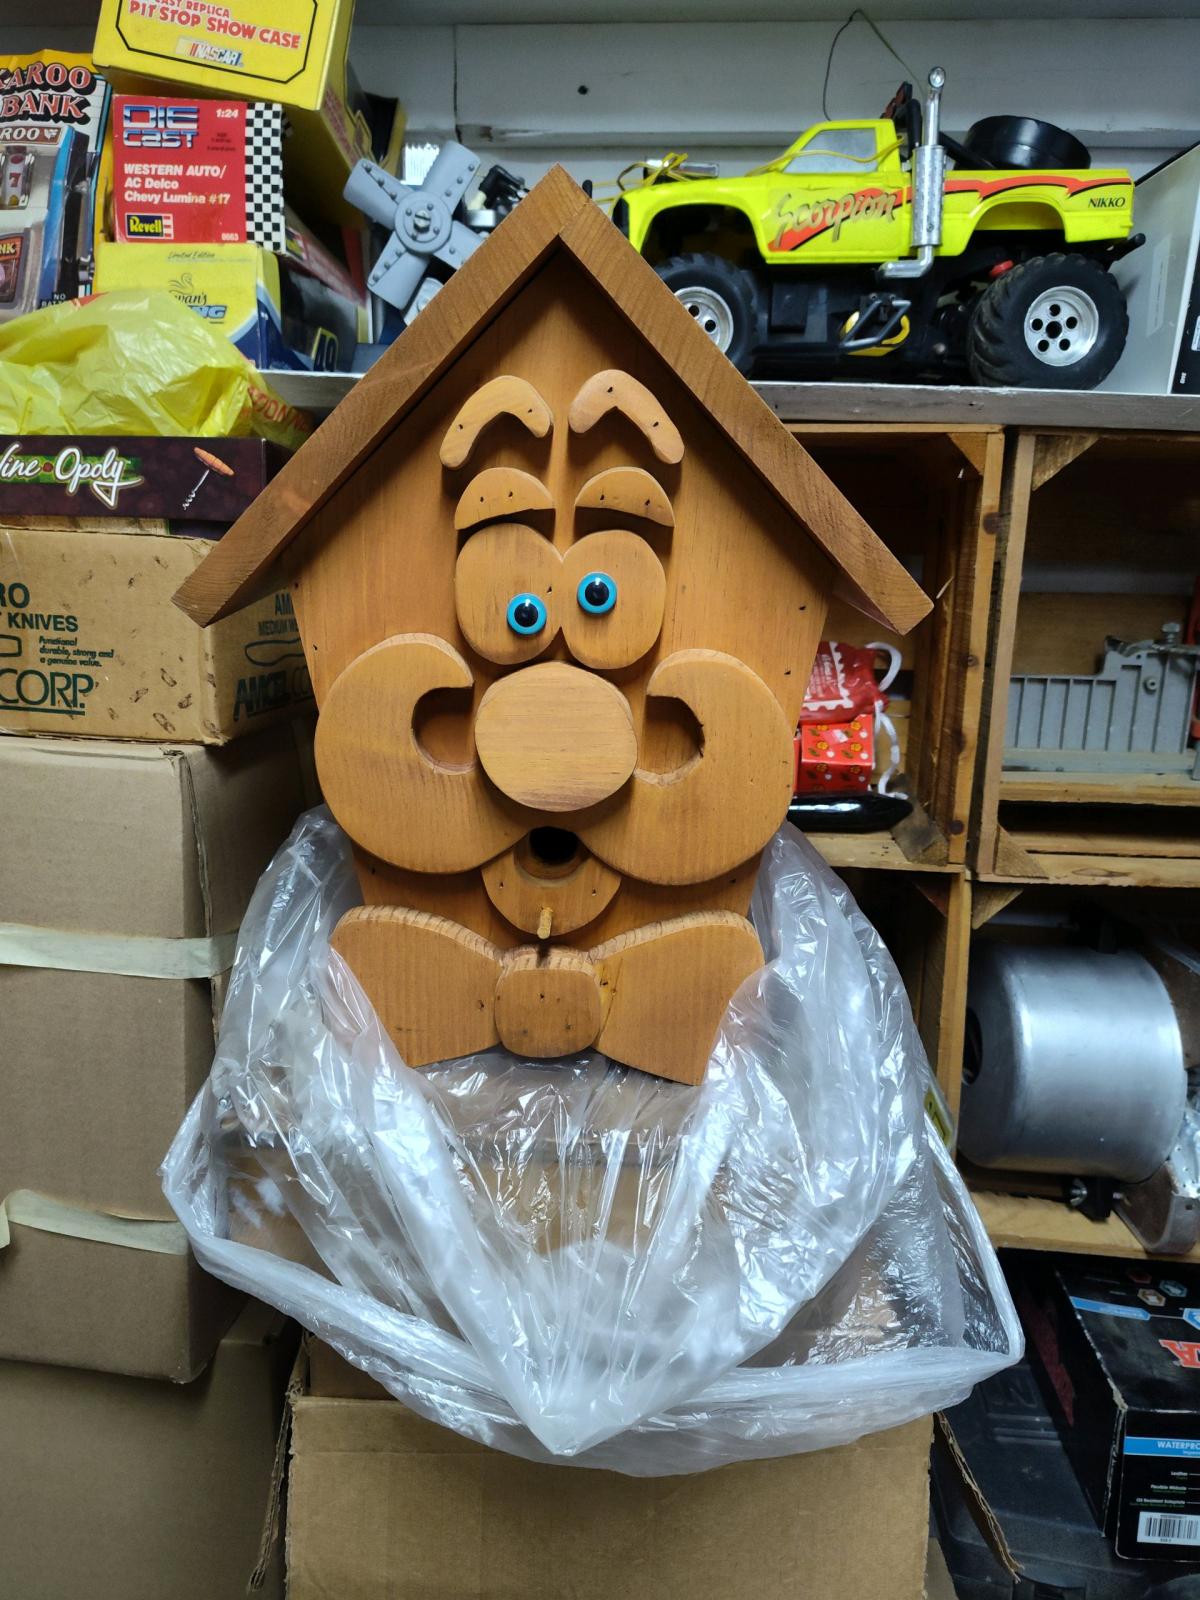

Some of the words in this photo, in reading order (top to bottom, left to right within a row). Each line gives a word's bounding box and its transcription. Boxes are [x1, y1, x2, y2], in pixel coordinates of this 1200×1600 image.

[186, 1, 230, 18] REPLICA
[129, 1, 157, 17] PIT
[159, 6, 201, 27] STOP
[206, 17, 256, 39] SHOW
[259, 28, 301, 49] CASE
[193, 43, 243, 66] NASCAR
[1, 91, 85, 118] BANK
[216, 108, 239, 118] 1:24
[123, 105, 198, 129] DIE
[124, 163, 183, 176] WESTERN
[186, 165, 227, 179] AUTO/
[124, 177, 142, 188] AC
[144, 178, 179, 190] Delco
[124, 190, 161, 204] Chevy
[163, 191, 206, 204] Lumina
[208, 193, 231, 205] #17
[1088, 197, 1126, 208] NIKKO
[129, 215, 162, 233] Revell
[774, 192, 897, 248] Scorpion
[174, 292, 207, 305] wan's
[55, 447, 142, 506] Opoly
[8, 612, 78, 632] KNIVES
[47, 658, 77, 666] genuine
[73, 648, 96, 659] strong
[98, 649, 114, 658] and
[0, 668, 94, 708] CORP.
